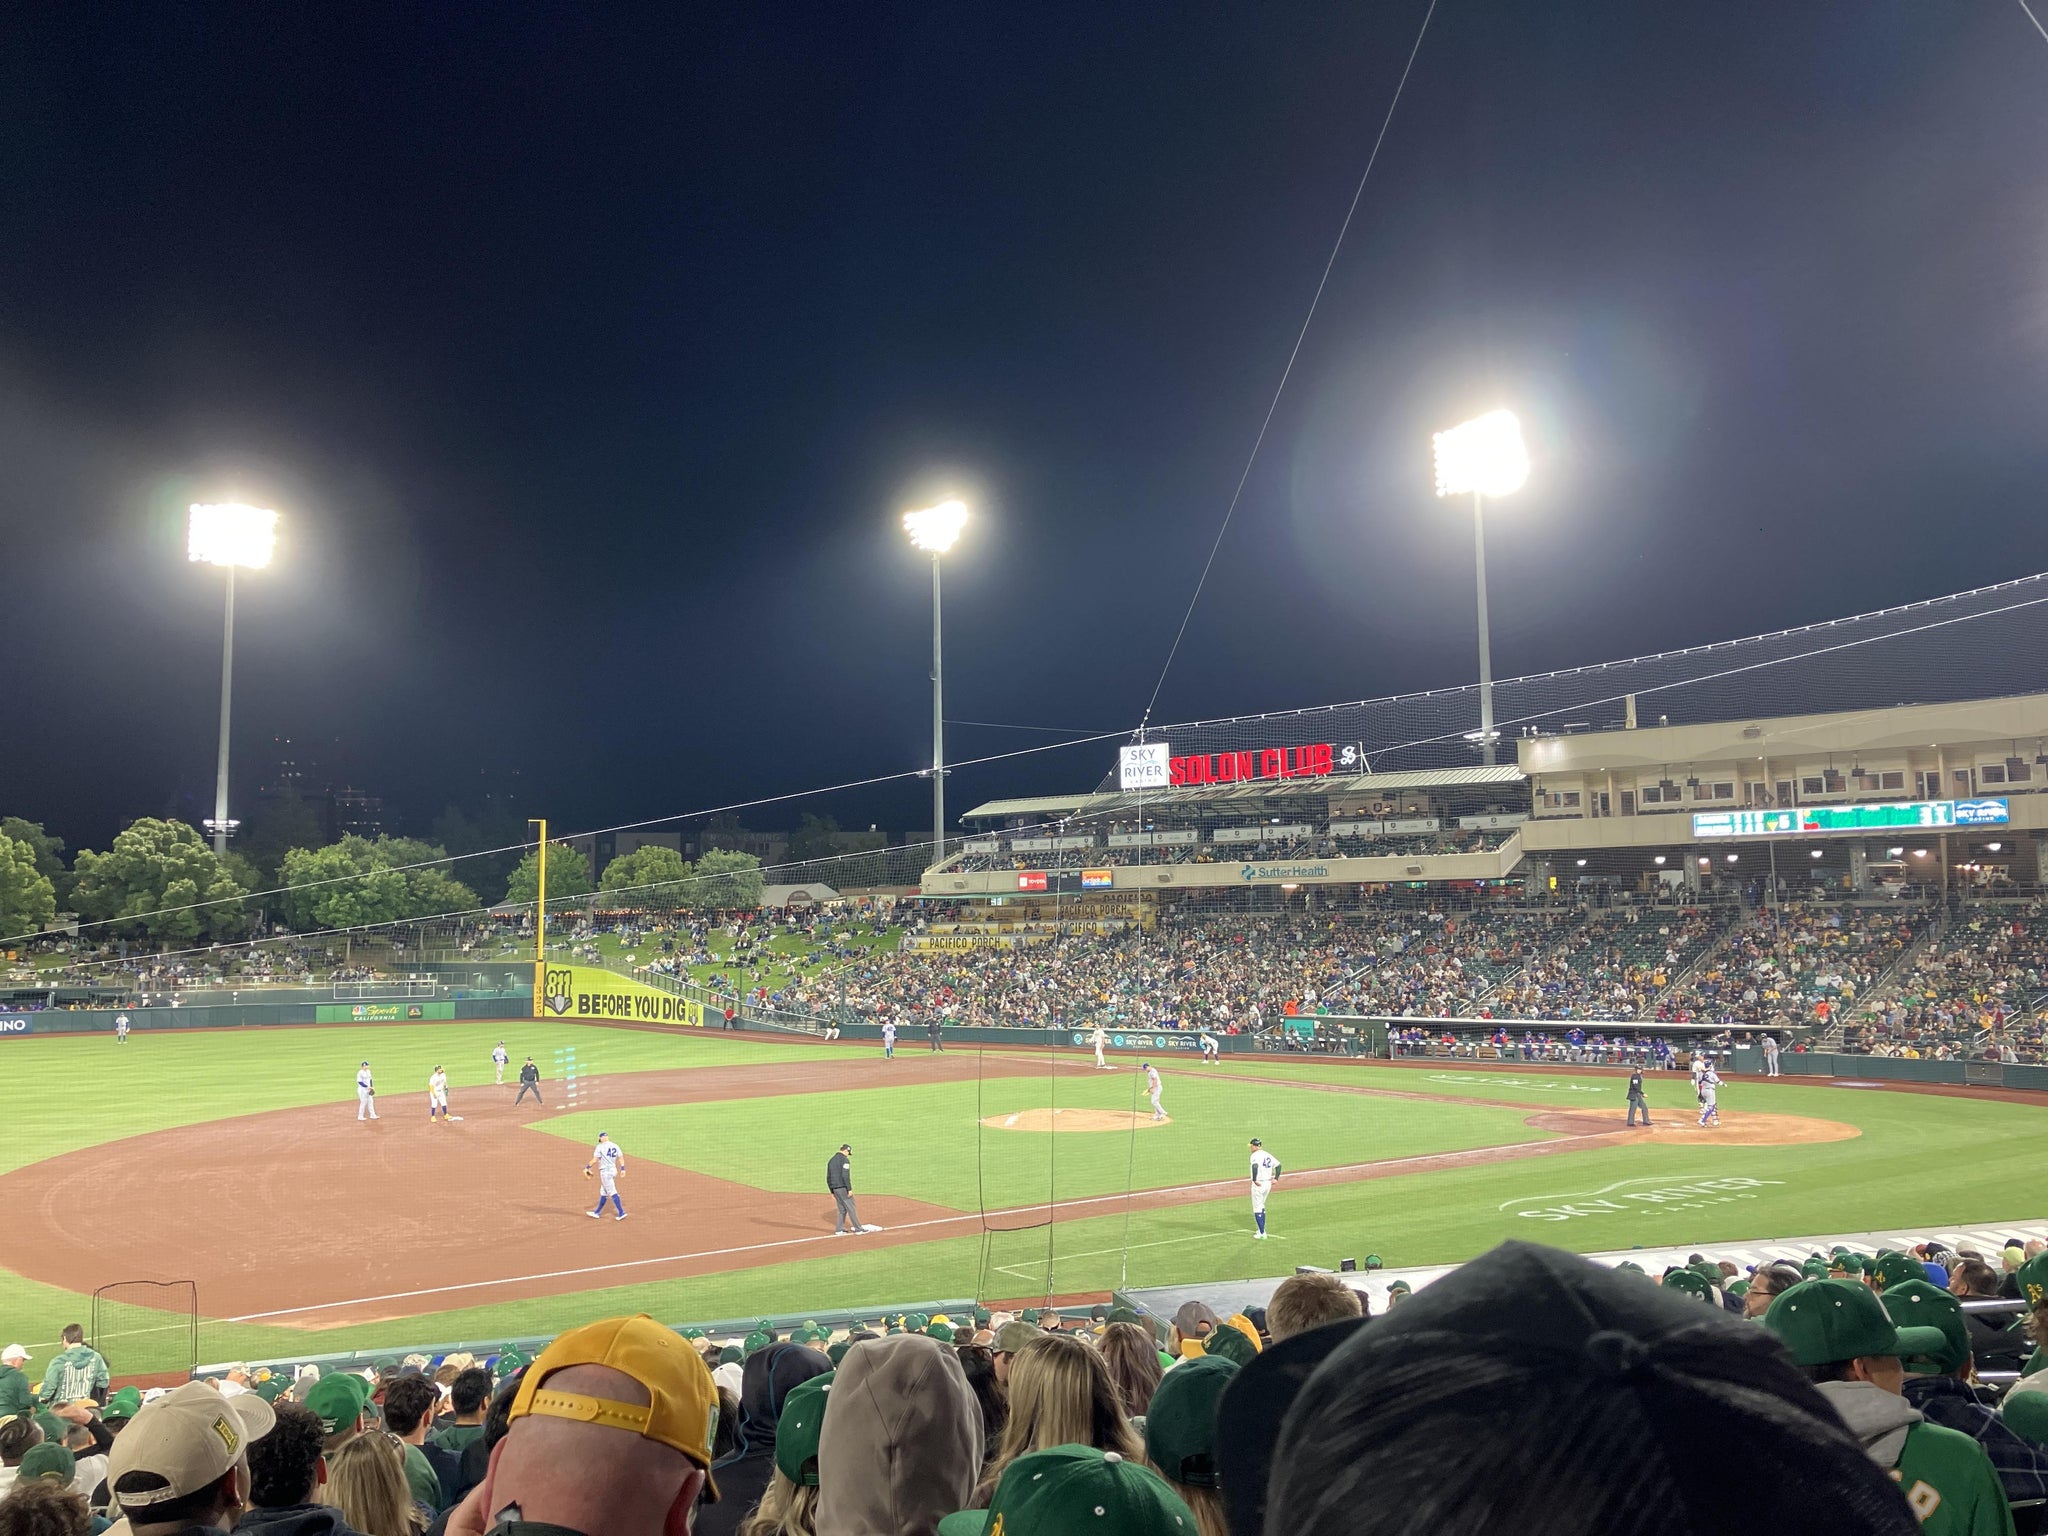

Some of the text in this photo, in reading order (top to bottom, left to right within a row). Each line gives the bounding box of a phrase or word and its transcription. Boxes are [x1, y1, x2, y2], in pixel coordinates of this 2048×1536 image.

[1131, 748, 1156, 760] SKY
[1125, 765, 1163, 778] RIVER
[1169, 744, 1334, 786] SOLON CLUB
[1060, 904, 1097, 915] PACIFICO
[1060, 922, 1097, 933] PCIFICO
[929, 937, 1000, 948] PACIFICO PORCH
[546, 970, 571, 998] 811
[366, 1004, 400, 1016] Sports
[578, 993, 686, 1021] BEFORE YOU DIG
[606, 1147, 617, 1158] 42
[1262, 1156, 1272, 1169] 42
[1517, 1177, 1786, 1221] SKY RIVER
[1641, 1193, 1758, 1215] CASINO
[2026, 1283, 2043, 1304] A's
